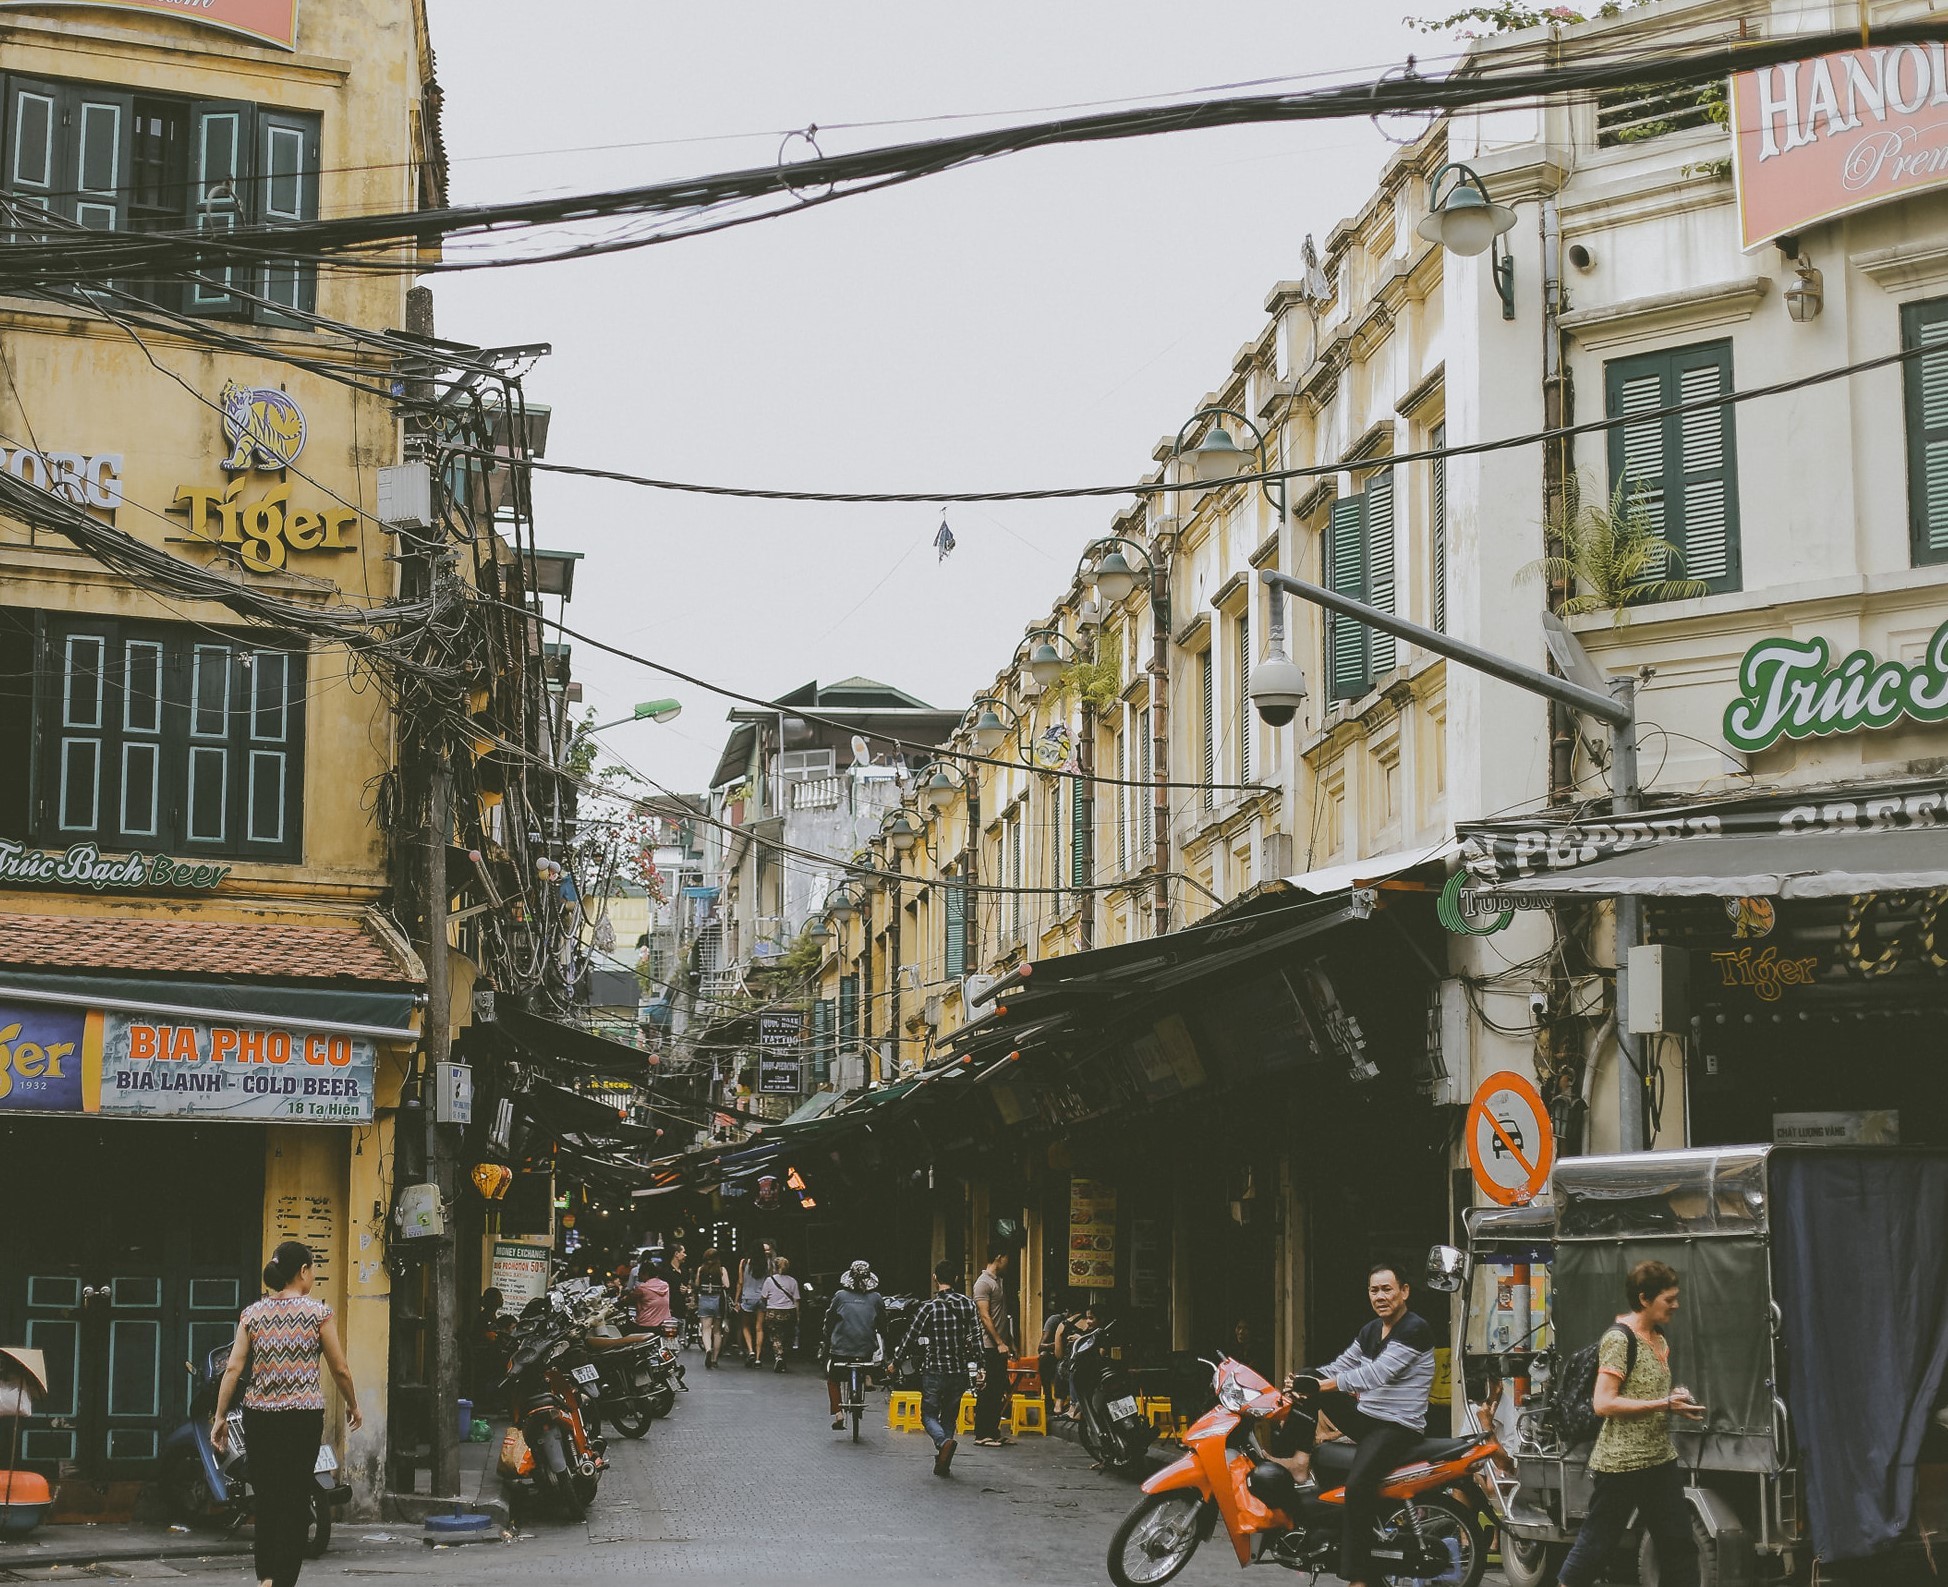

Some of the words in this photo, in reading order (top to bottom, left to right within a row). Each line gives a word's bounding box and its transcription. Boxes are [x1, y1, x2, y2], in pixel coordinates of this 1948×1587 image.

[0, 448, 123, 508] ORG
[175, 477, 357, 572] Tiger
[1730, 644, 1902, 741] Trúc
[57, 845, 144, 887] Bạch
[149, 853, 232, 889] Beer
[1460, 887, 1554, 917] TUBOR
[1711, 947, 1818, 1002] Tiger
[129, 1025, 199, 1061] BIA
[210, 1028, 293, 1066] PHO
[303, 1032, 353, 1068] CO
[20, 1081, 47, 1090] 1932
[116, 1070, 155, 1090] BIA
[161, 1072, 222, 1094] LẠNH
[242, 1075, 299, 1095] COLD
[302, 1077, 359, 1098] BEER
[288, 1102, 304, 1114] 18
[496, 1247, 516, 1257] MONEY
[517, 1248, 546, 1259] EXCHANGE
[502, 1262, 529, 1271] PROMOTION
[530, 1261, 546, 1273] 50%
